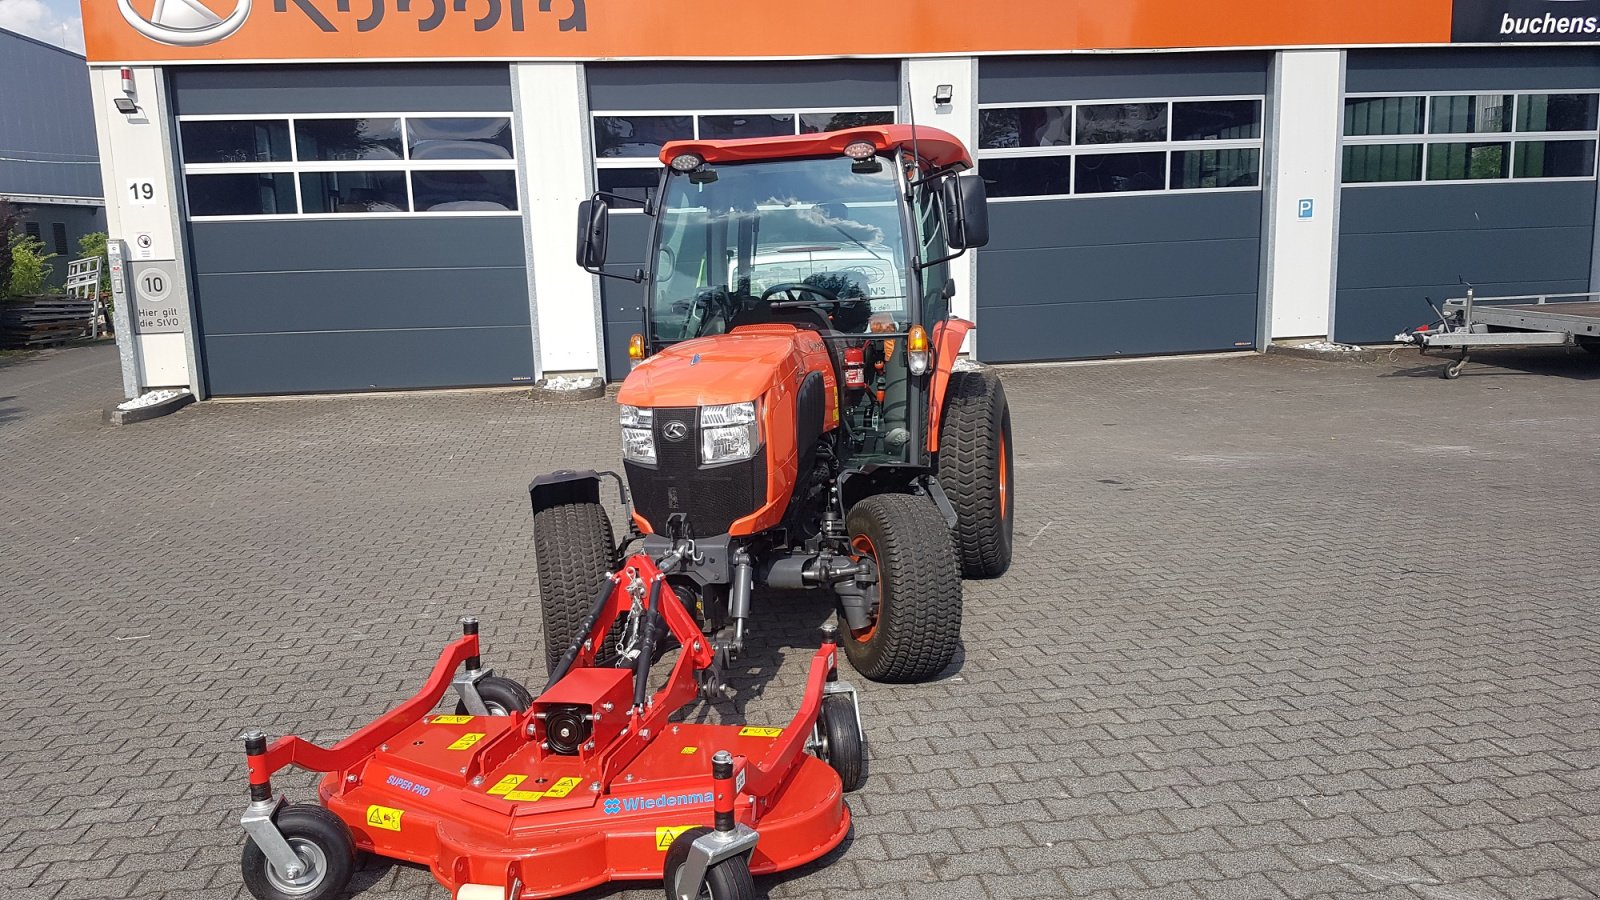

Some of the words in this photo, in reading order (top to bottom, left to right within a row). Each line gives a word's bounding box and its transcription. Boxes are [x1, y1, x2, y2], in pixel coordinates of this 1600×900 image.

[130, 183, 153, 200] 19
[1300, 201, 1311, 216] P
[145, 277, 163, 292] 10
[139, 309, 158, 317] Hier
[162, 308, 178, 318] gilt
[157, 319, 179, 327] StVO
[386, 774, 413, 791] SUPER
[412, 783, 431, 797] PRO
